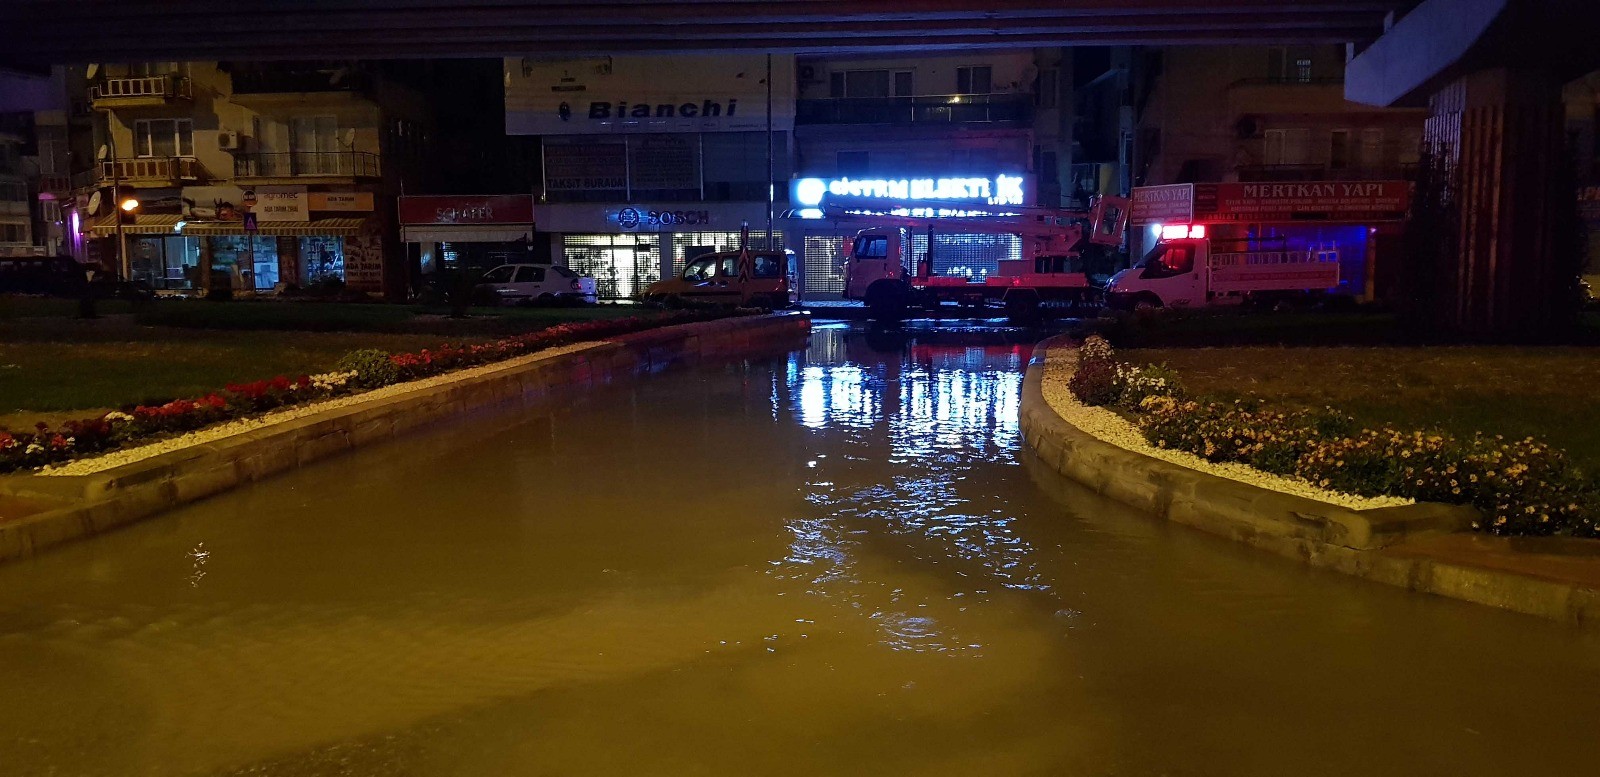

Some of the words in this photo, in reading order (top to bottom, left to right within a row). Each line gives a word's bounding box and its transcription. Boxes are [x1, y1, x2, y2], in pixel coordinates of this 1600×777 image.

[589, 99, 738, 119] Bianchi
[547, 178, 581, 188] TAKSİT
[1243, 183, 1334, 197] MERTKAN
[1342, 182, 1383, 196] YAPI
[264, 192, 298, 201] agromec
[1134, 188, 1171, 202] MERTKAN
[1172, 187, 1192, 200] YAPI
[648, 210, 709, 225] BOSCH
